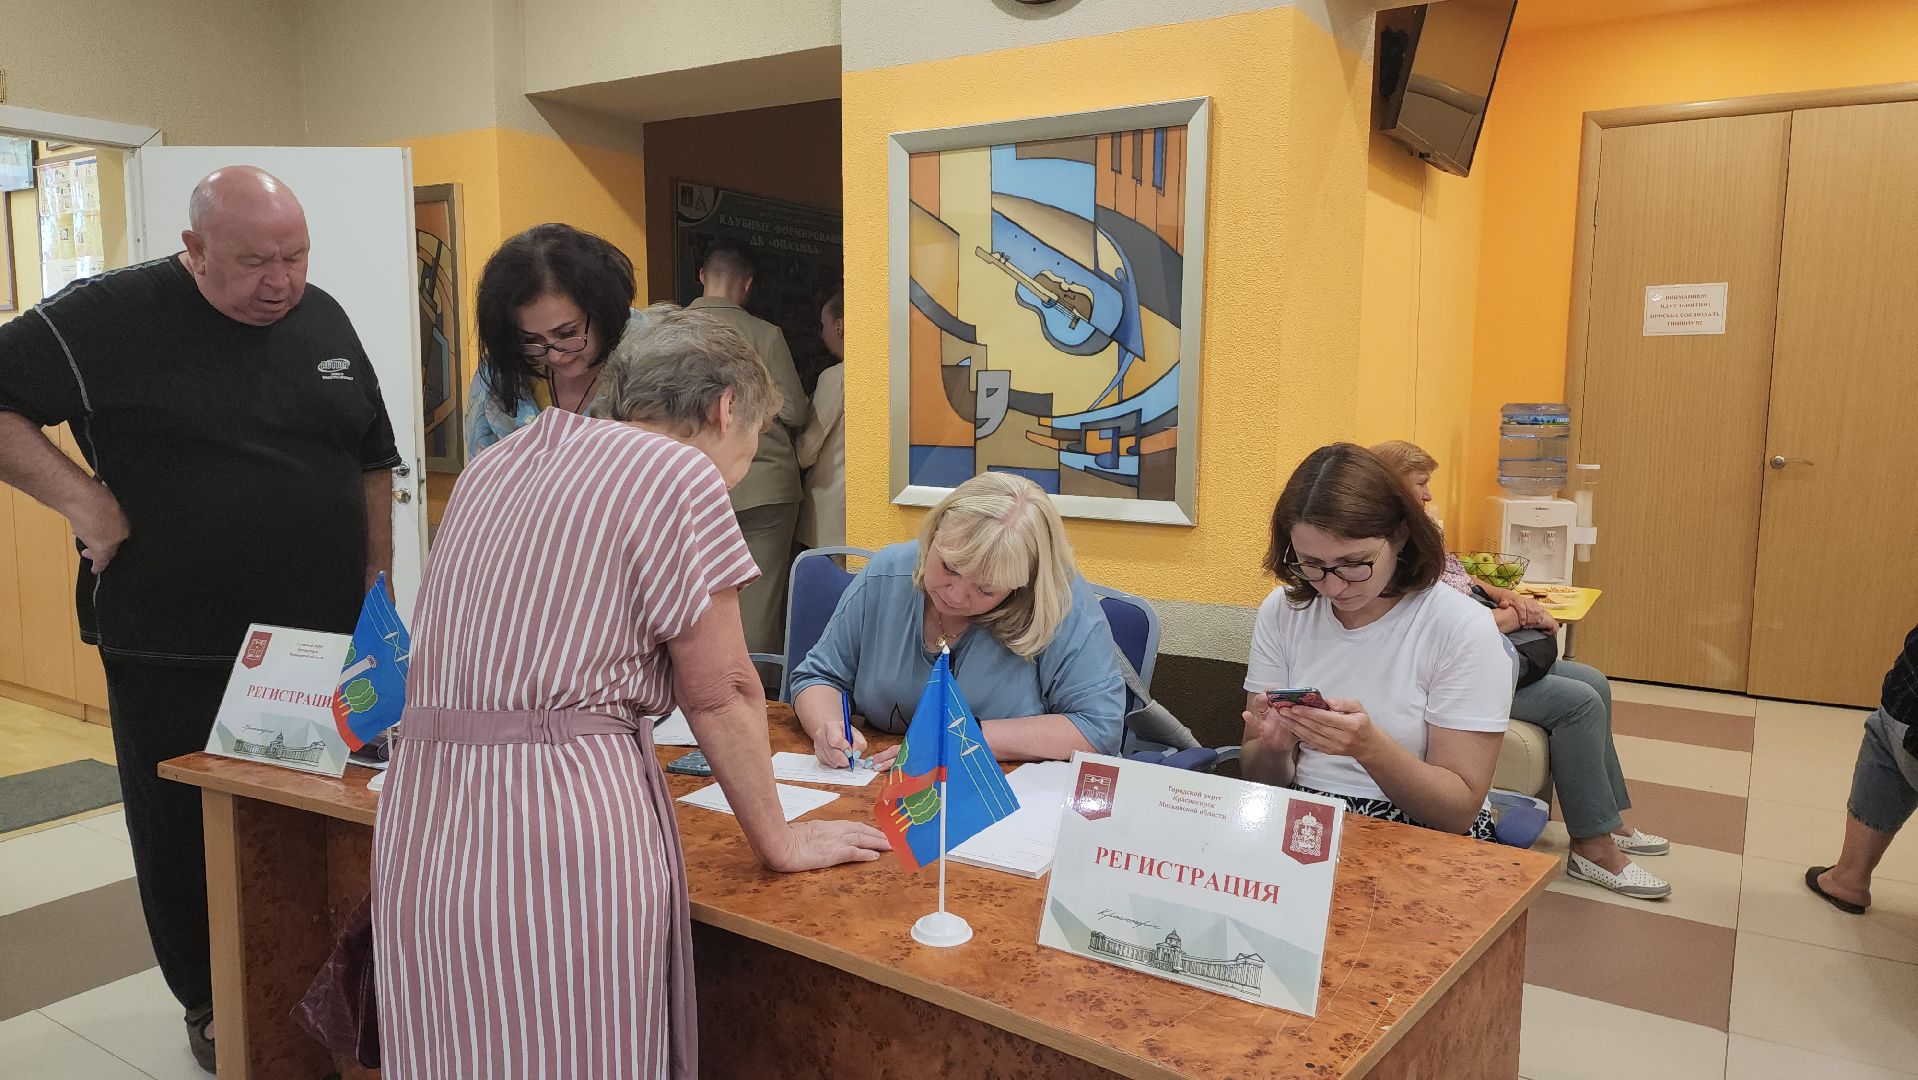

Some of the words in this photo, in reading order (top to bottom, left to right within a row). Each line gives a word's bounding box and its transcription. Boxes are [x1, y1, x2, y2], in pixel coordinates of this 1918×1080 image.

[719, 214, 772, 233] КЛУБНЫЕ
[774, 223, 842, 244] ФОРМИРОВАНИ
[246, 684, 333, 709] РЕГИСТРАЦИ
[1168, 785, 1202, 798] Городской
[1203, 793, 1223, 801] округ
[1172, 795, 1216, 808] Красногорск
[1158, 800, 1198, 814] Московской
[1199, 809, 1227, 820] области
[1093, 846, 1280, 904] РЕГИСТРАЦИЯ
